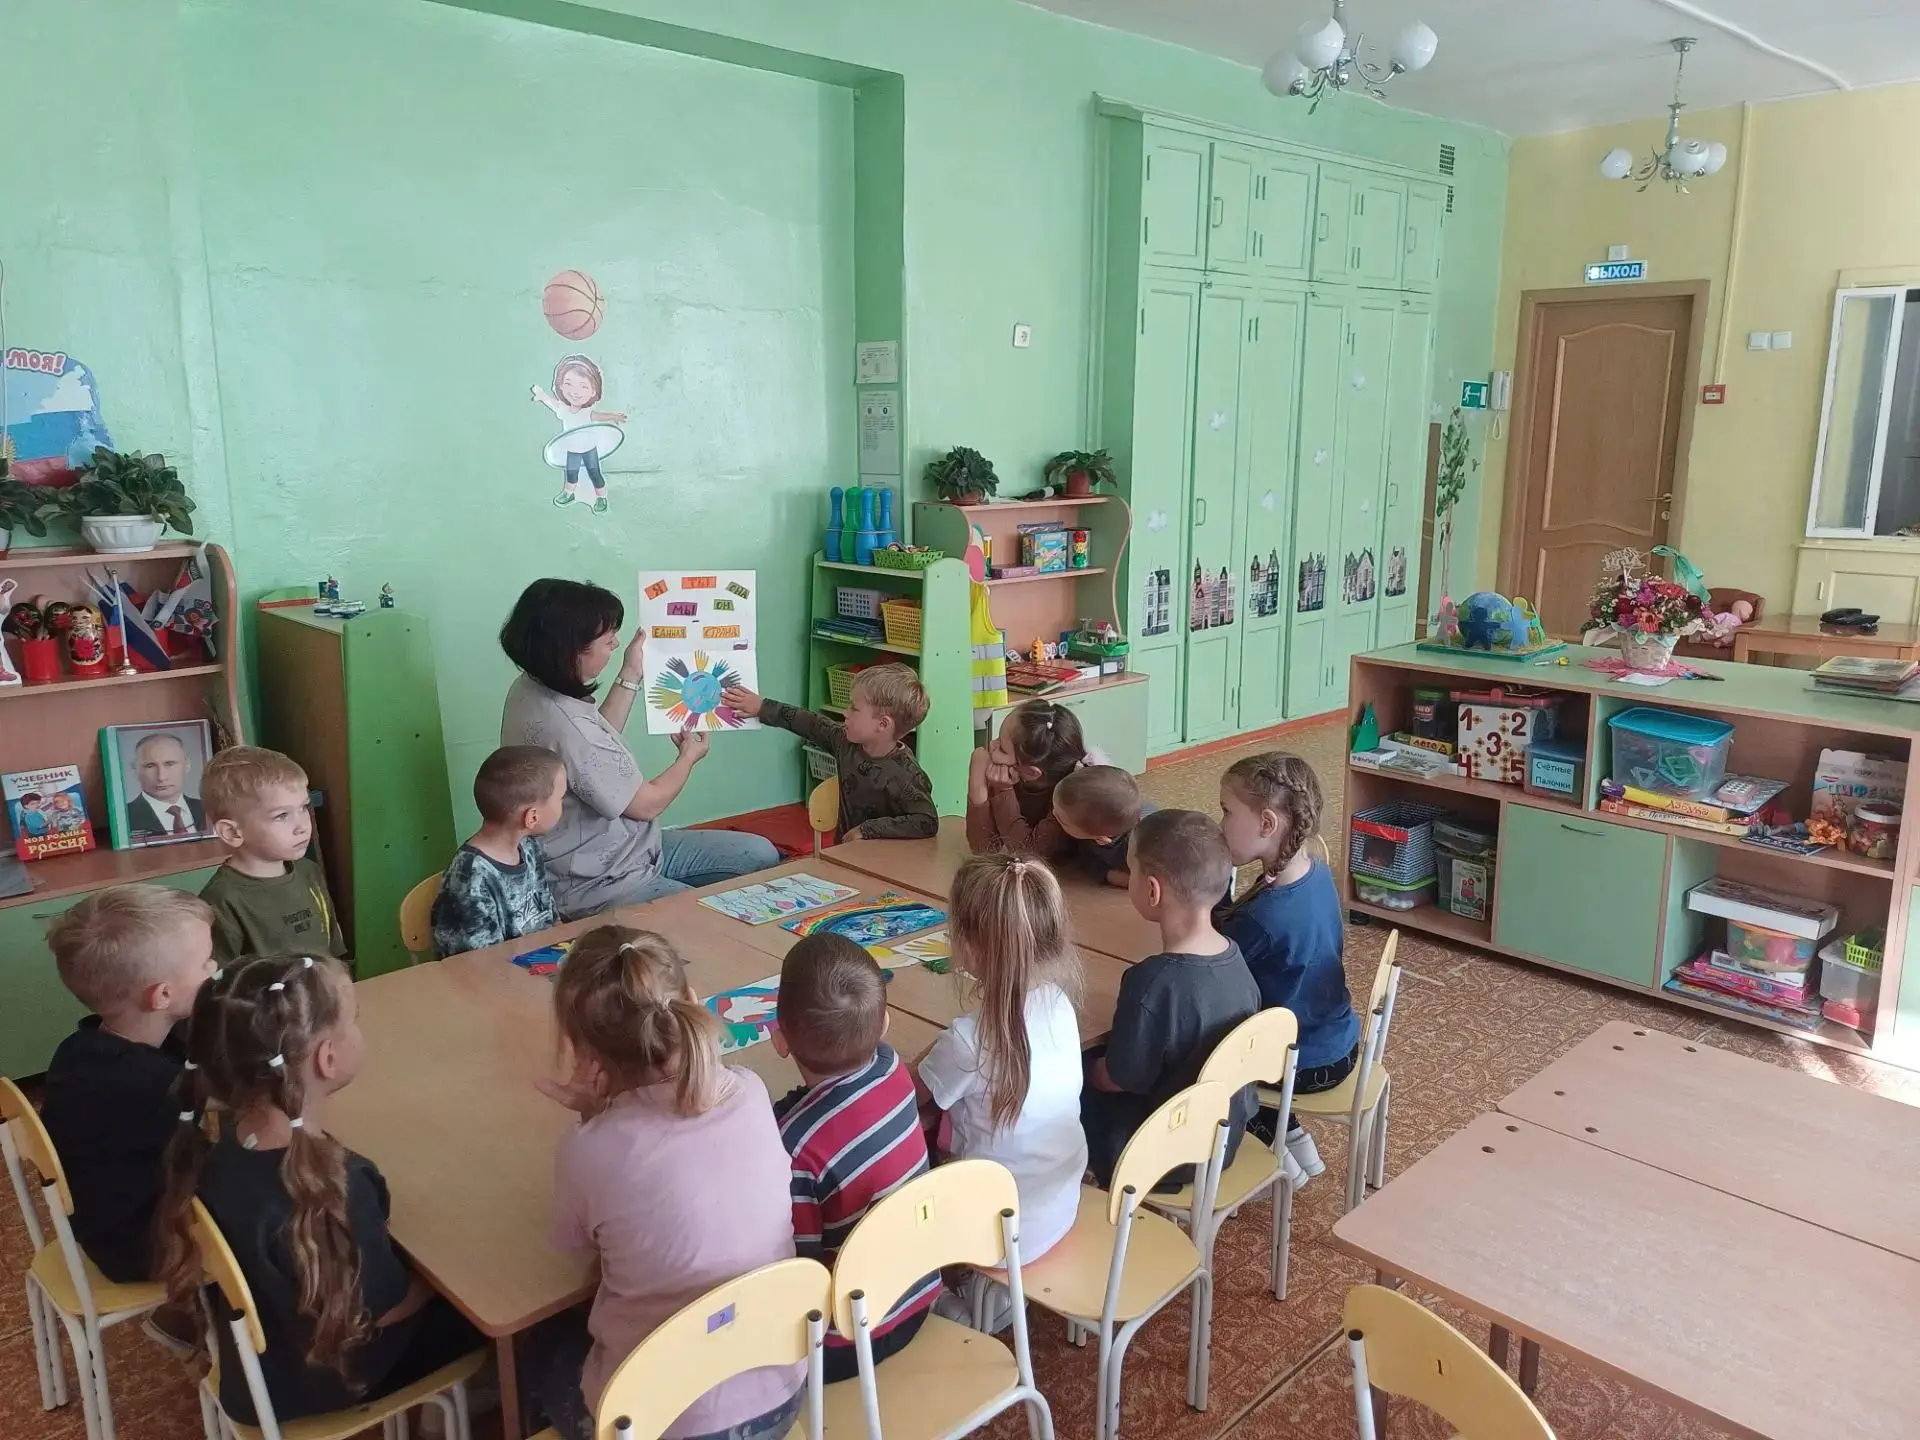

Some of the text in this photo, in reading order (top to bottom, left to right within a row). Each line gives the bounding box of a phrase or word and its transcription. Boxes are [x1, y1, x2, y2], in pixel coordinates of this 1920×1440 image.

[687, 579, 709, 589] ТЫ
[729, 584, 747, 599] ОНА
[672, 601, 730, 615] МЫ ОН
[1459, 707, 1527, 737] 1 2
[1486, 731, 1502, 757] 3
[10, 770, 74, 784] УЧЕБНИК
[1457, 753, 1472, 779] 4
[1510, 759, 1526, 784] 5
[23, 828, 89, 845] МОЯ РОДИНА
[28, 835, 89, 856] РОССИЯ
